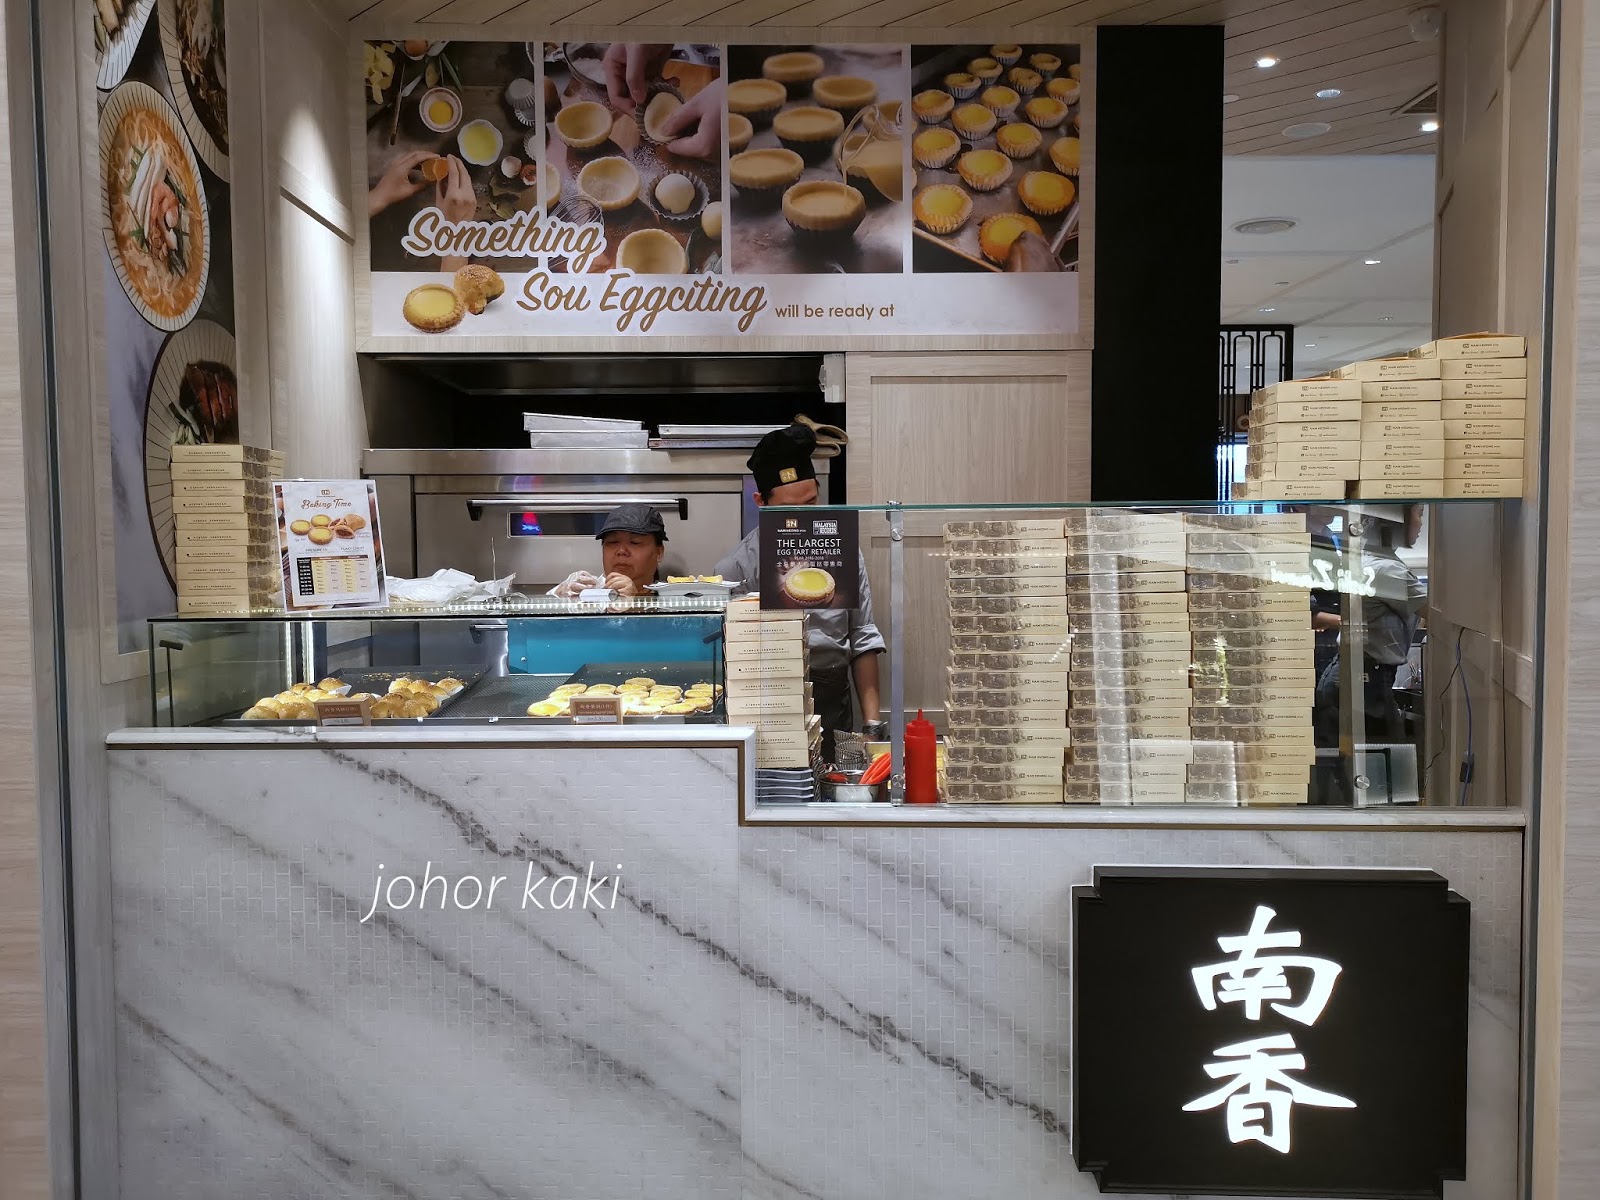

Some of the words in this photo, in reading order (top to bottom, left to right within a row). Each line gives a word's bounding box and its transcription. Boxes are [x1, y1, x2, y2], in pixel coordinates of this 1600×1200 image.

[407, 211, 601, 273] Something
[517, 271, 592, 311] Sou
[600, 272, 768, 332] Eggciting
[775, 303, 800, 317] will
[804, 303, 824, 317] be
[829, 303, 875, 321] ready
[880, 304, 895, 317] at
[301, 499, 333, 509] Baking
[776, 539, 796, 548] THE
[798, 538, 842, 548] LARGEST
[776, 548, 791, 556] EGG
[793, 548, 810, 556] TART
[811, 548, 842, 556] RETAILER
[1181, 905, 1358, 1154] 南香
